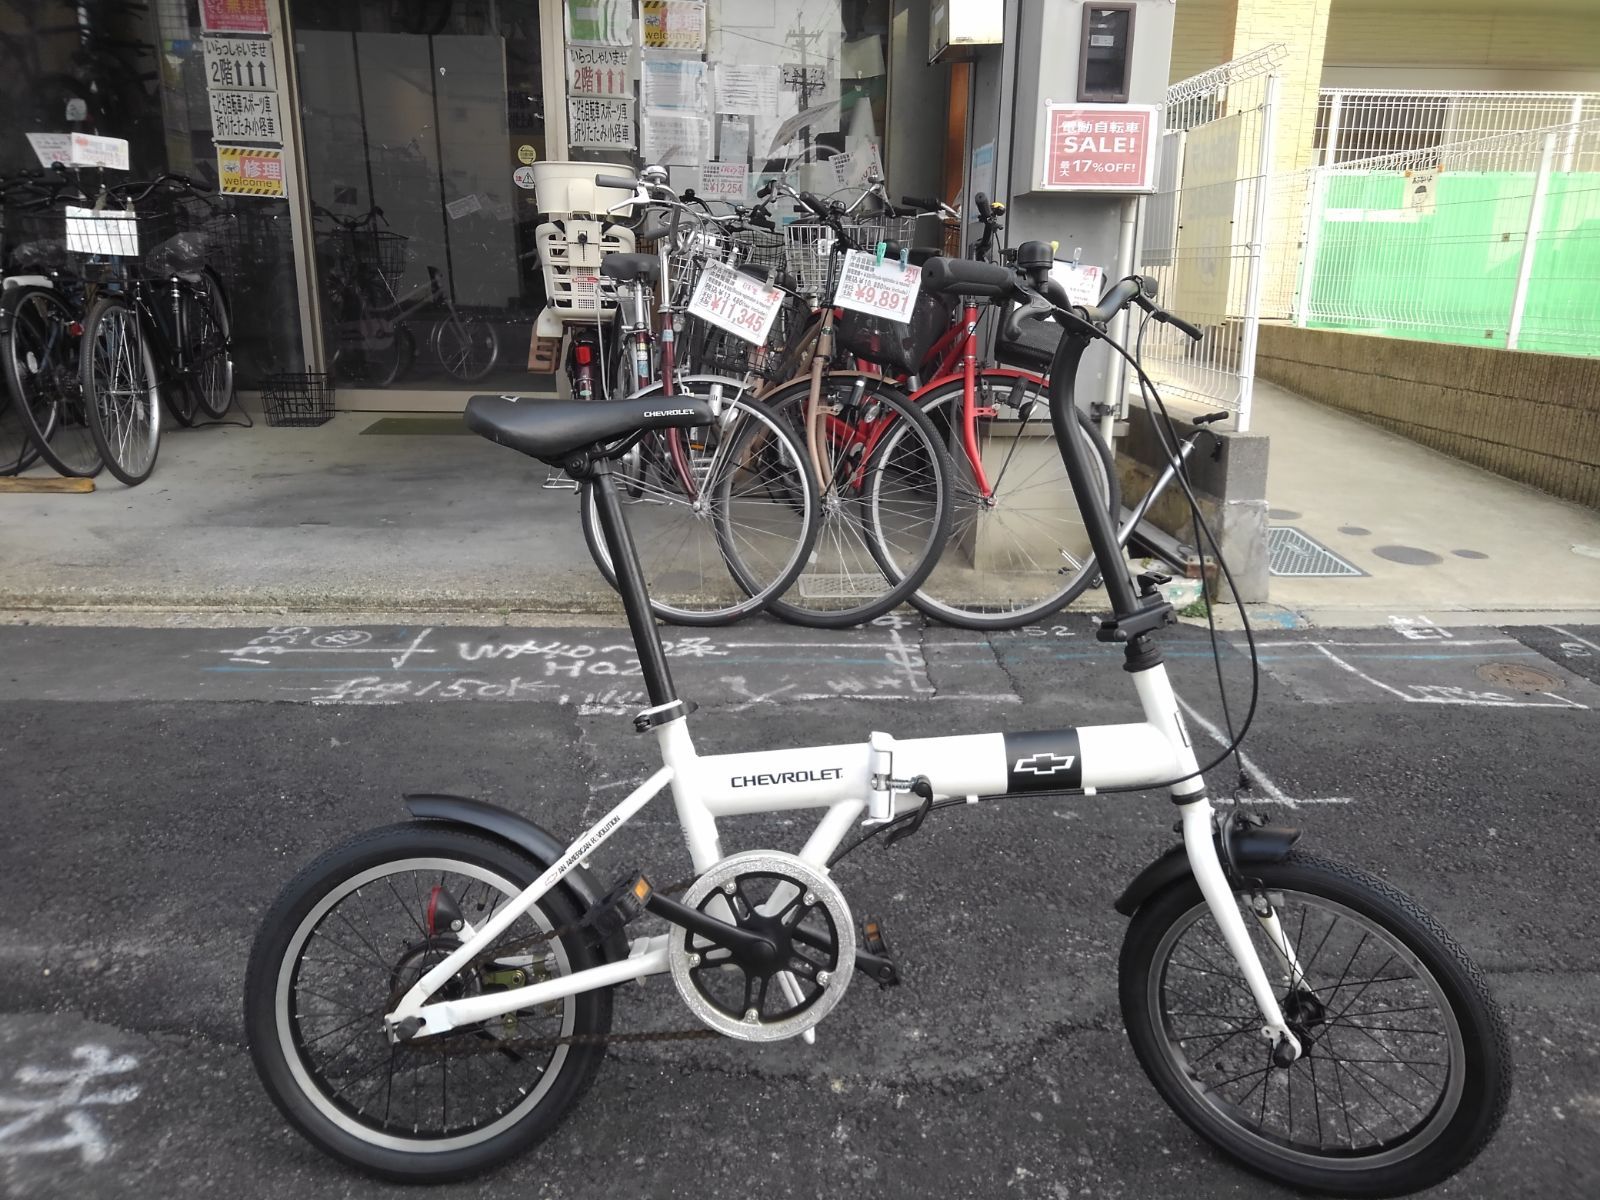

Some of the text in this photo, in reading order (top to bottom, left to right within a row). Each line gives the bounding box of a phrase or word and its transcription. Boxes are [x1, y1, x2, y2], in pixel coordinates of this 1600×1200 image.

[206, 40, 267, 57] いらっしゃいませ
[569, 48, 627, 65] いらっしゃいませ
[211, 58, 233, 86] 2階
[574, 66, 593, 93] 2階
[1060, 120, 1140, 134] 電動自転車
[1063, 136, 1136, 154] SALE!
[243, 159, 282, 180] 修理
[223, 177, 272, 188] welcome
[855, 284, 909, 315] ¥9,891
[711, 294, 765, 333] ¥11,345
[643, 408, 694, 418] CHEVROLET
[731, 767, 843, 788] CHEVROLET
[566, 841, 592, 866] AMERICAN
